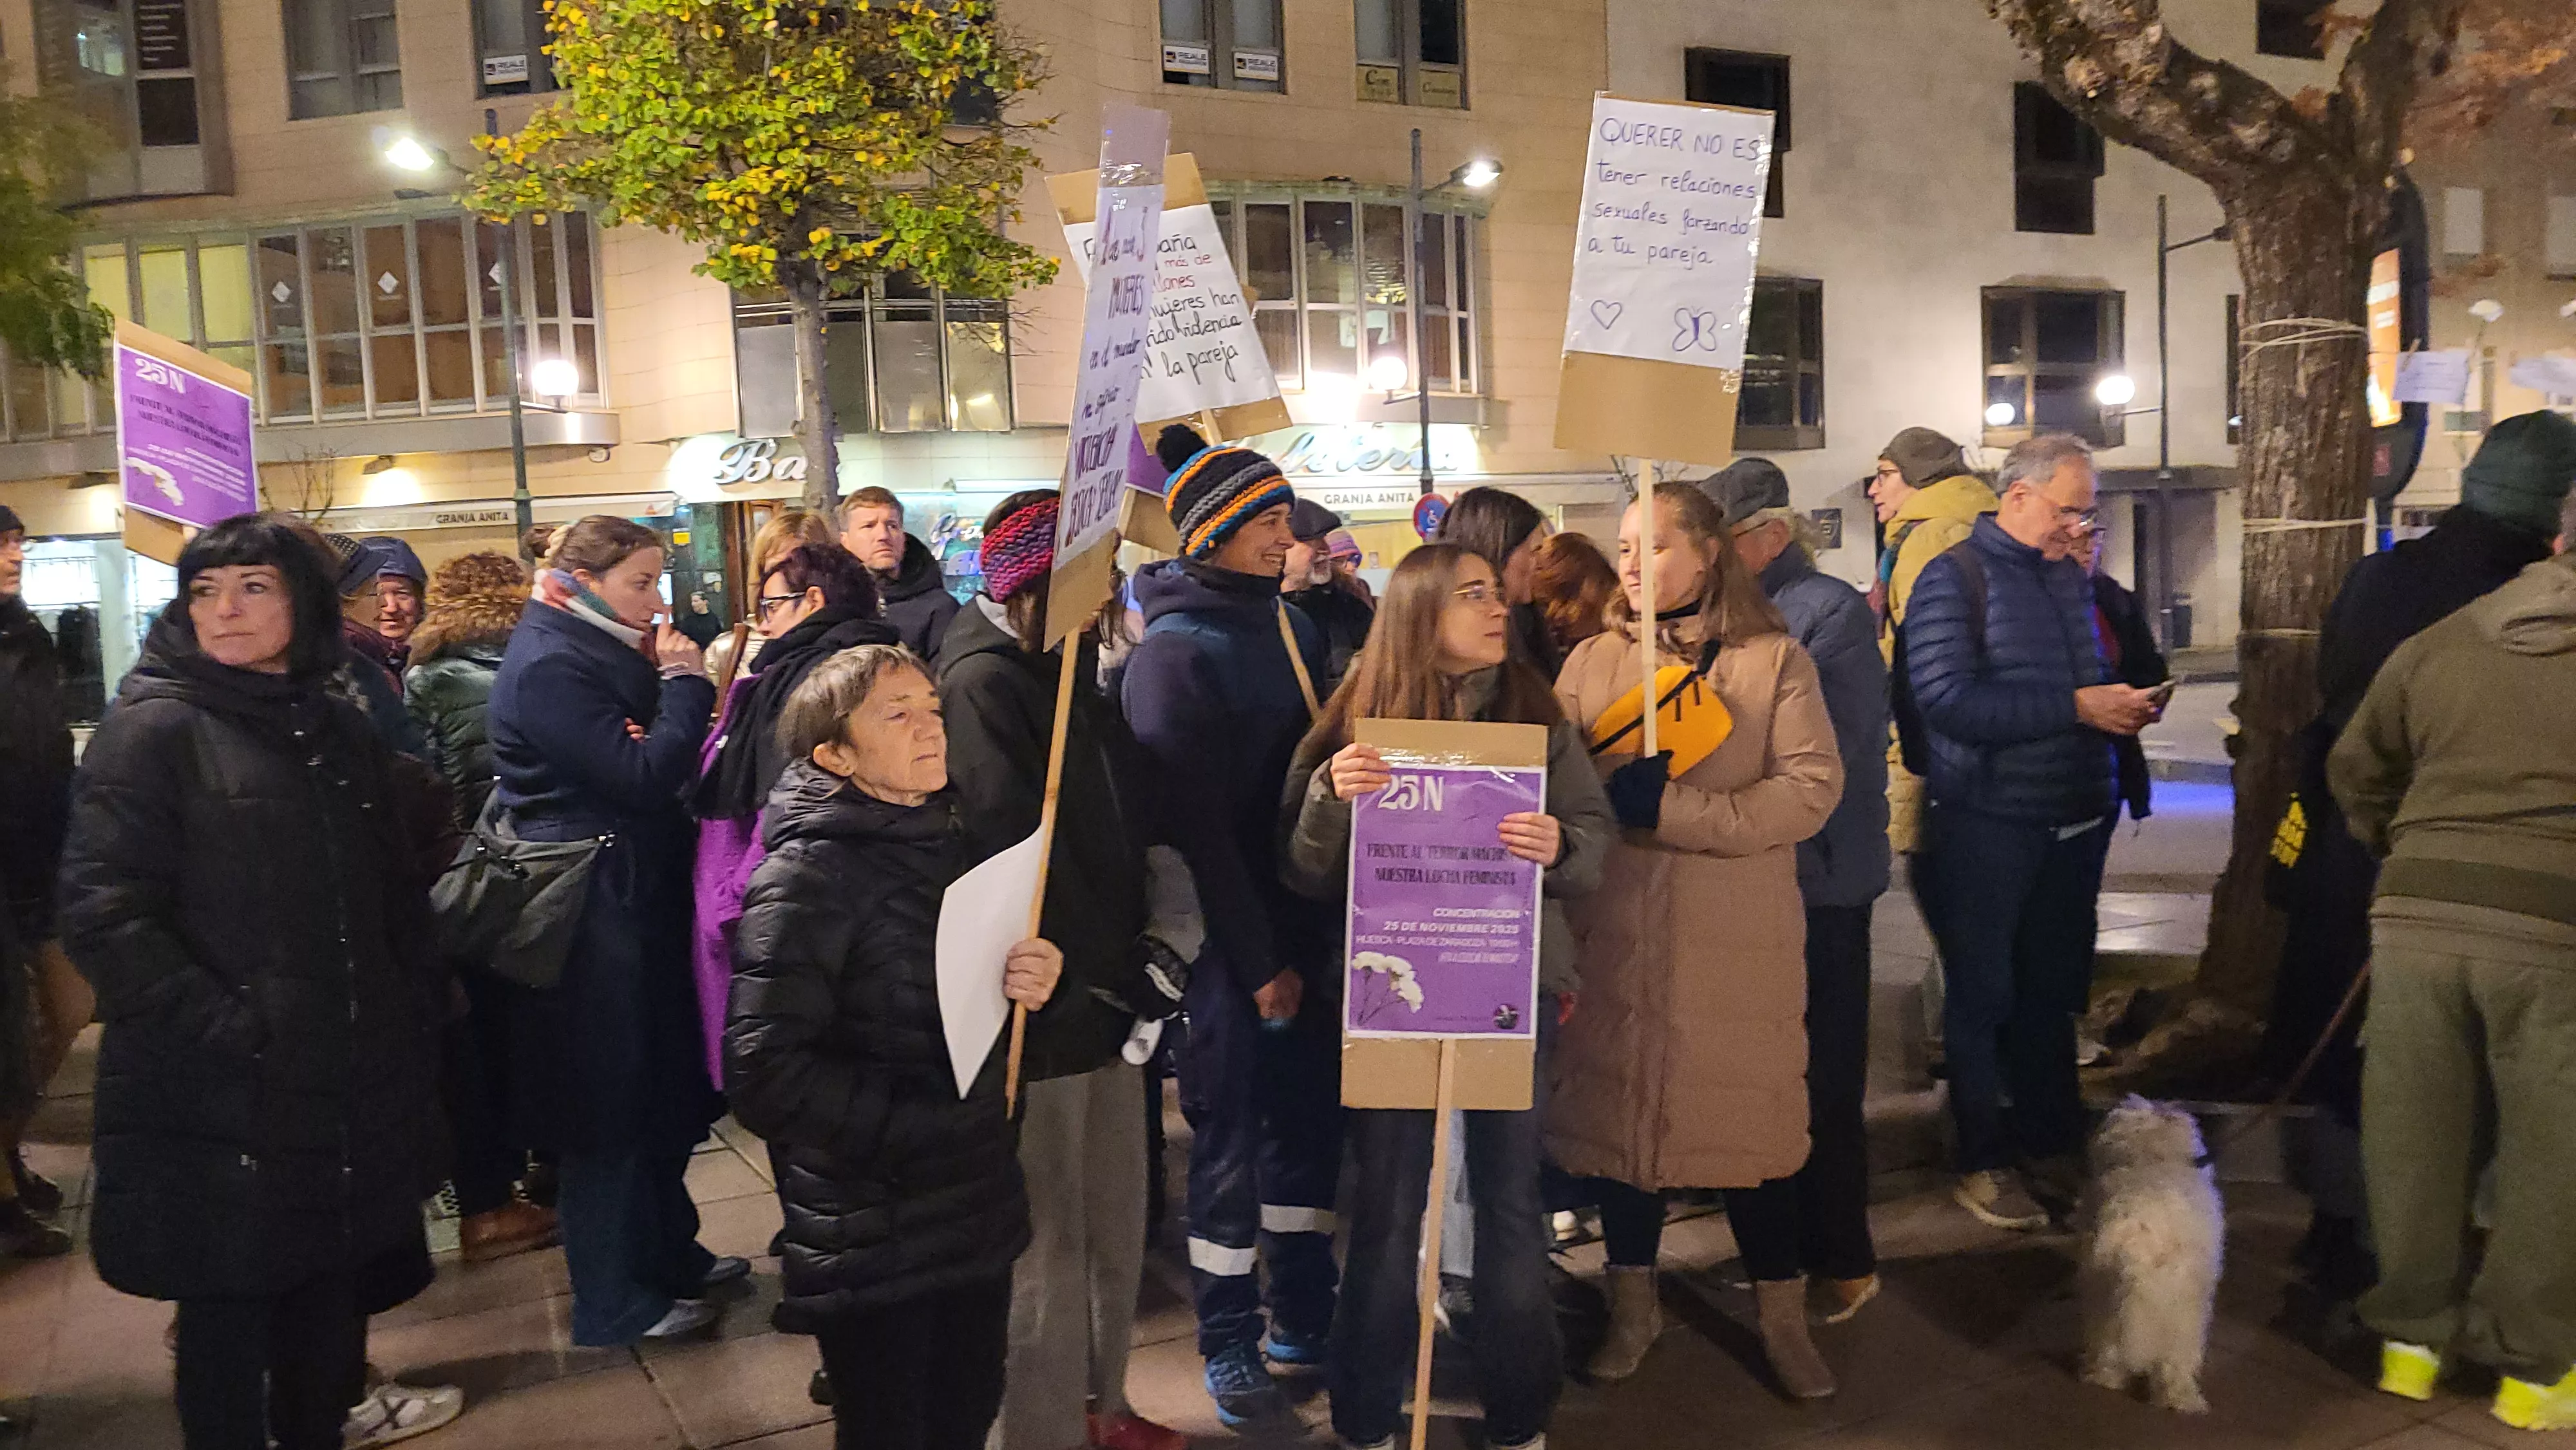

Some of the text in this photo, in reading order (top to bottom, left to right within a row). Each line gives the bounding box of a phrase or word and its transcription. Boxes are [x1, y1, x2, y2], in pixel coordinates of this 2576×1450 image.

[1600, 117, 1761, 160] QUERER NO ES
[1596, 158, 1757, 199] tener relaciones
[1591, 202, 1748, 236] sexuales forzando
[1164, 253, 1212, 267] más de
[1588, 235, 1714, 270] a tu pareja
[1208, 287, 1240, 306] han
[1172, 311, 1243, 337] violencia
[134, 357, 187, 394] 25N
[1160, 351, 1185, 378] la
[1186, 341, 1239, 385] pareja
[713, 438, 809, 485] Ba
[1324, 493, 1415, 505] GRANJA ANITA
[435, 511, 508, 523] GRANJA ANITA
[1378, 774, 1444, 811] 25N
[1383, 921, 1399, 931] 25
[1401, 921, 1418, 932] DE
[1419, 922, 1489, 933] NOVIEMBRE
